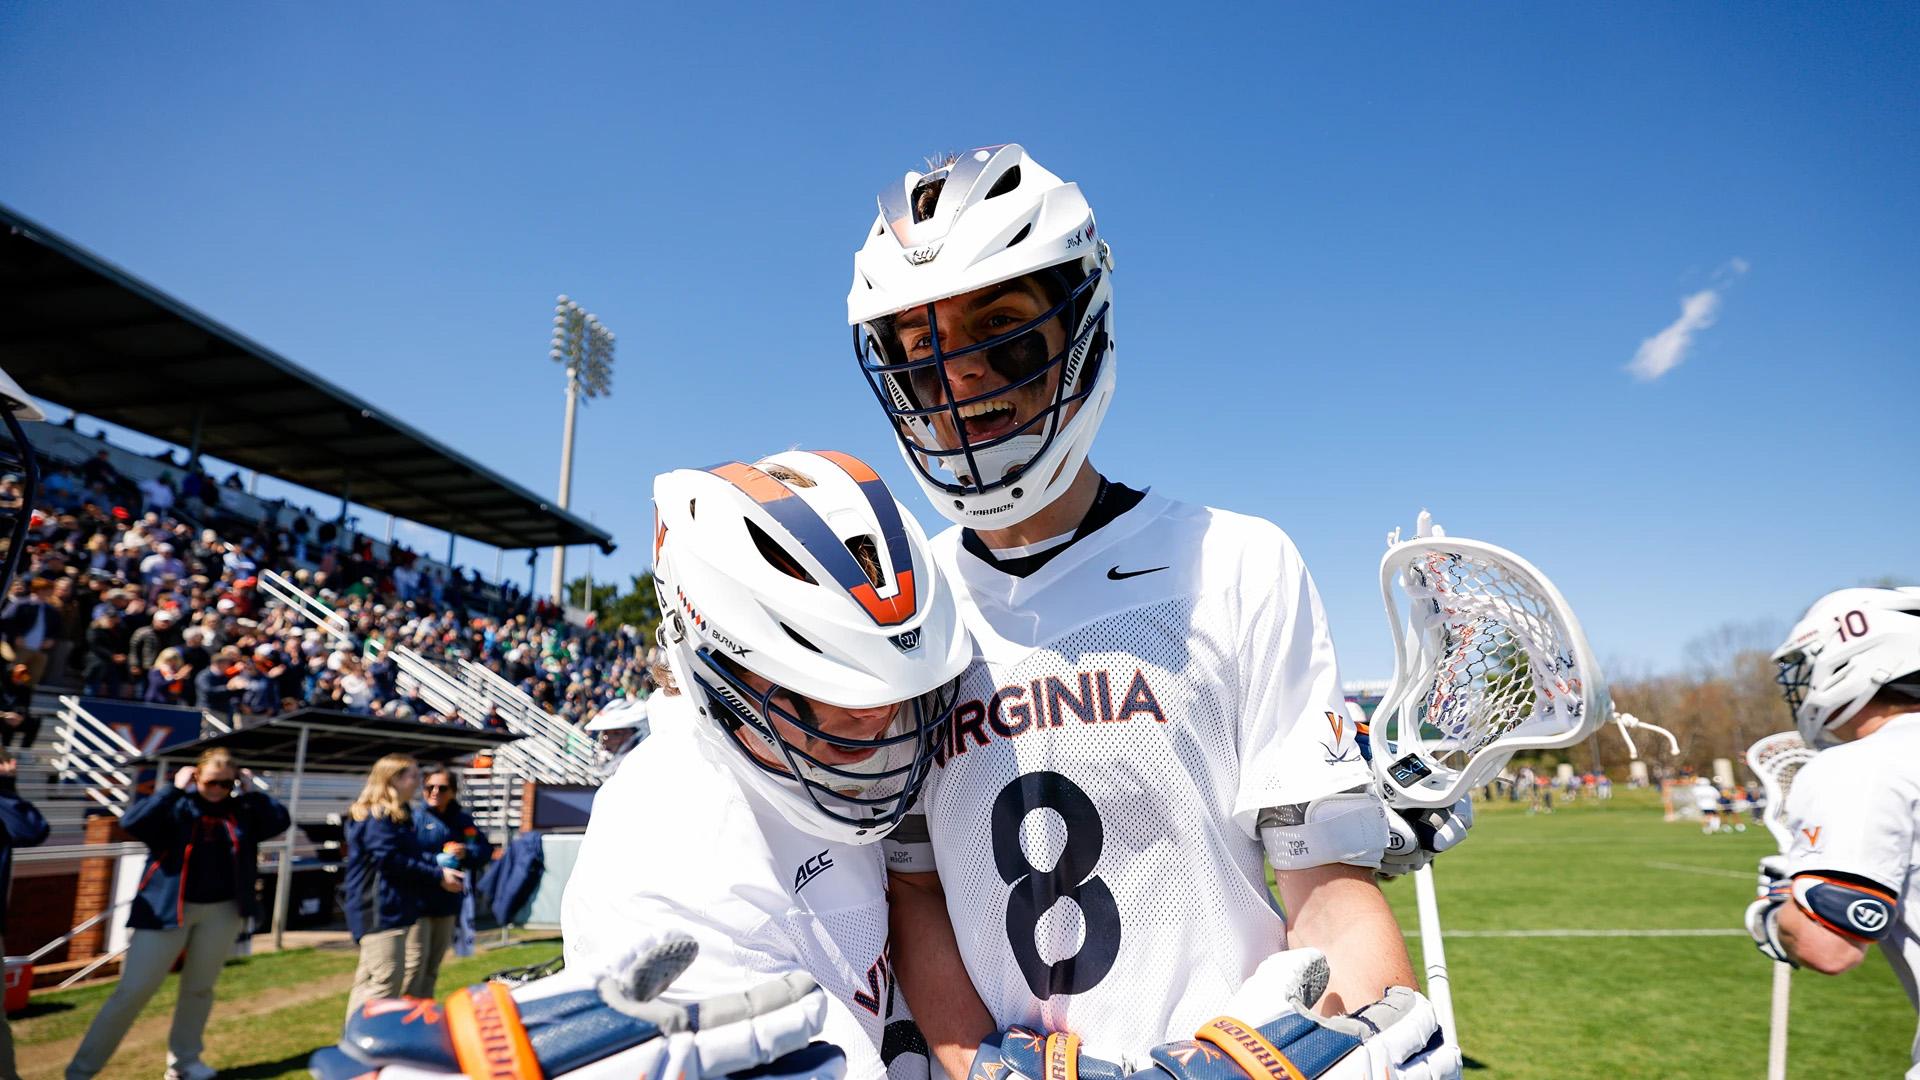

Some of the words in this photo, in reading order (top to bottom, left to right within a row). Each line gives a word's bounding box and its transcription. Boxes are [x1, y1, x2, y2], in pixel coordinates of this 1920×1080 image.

[1289, 840, 1305, 849] TOP
[1289, 848, 1309, 857] LEFT
[795, 849, 833, 889] ACC
[991, 770, 1121, 1001] 8
